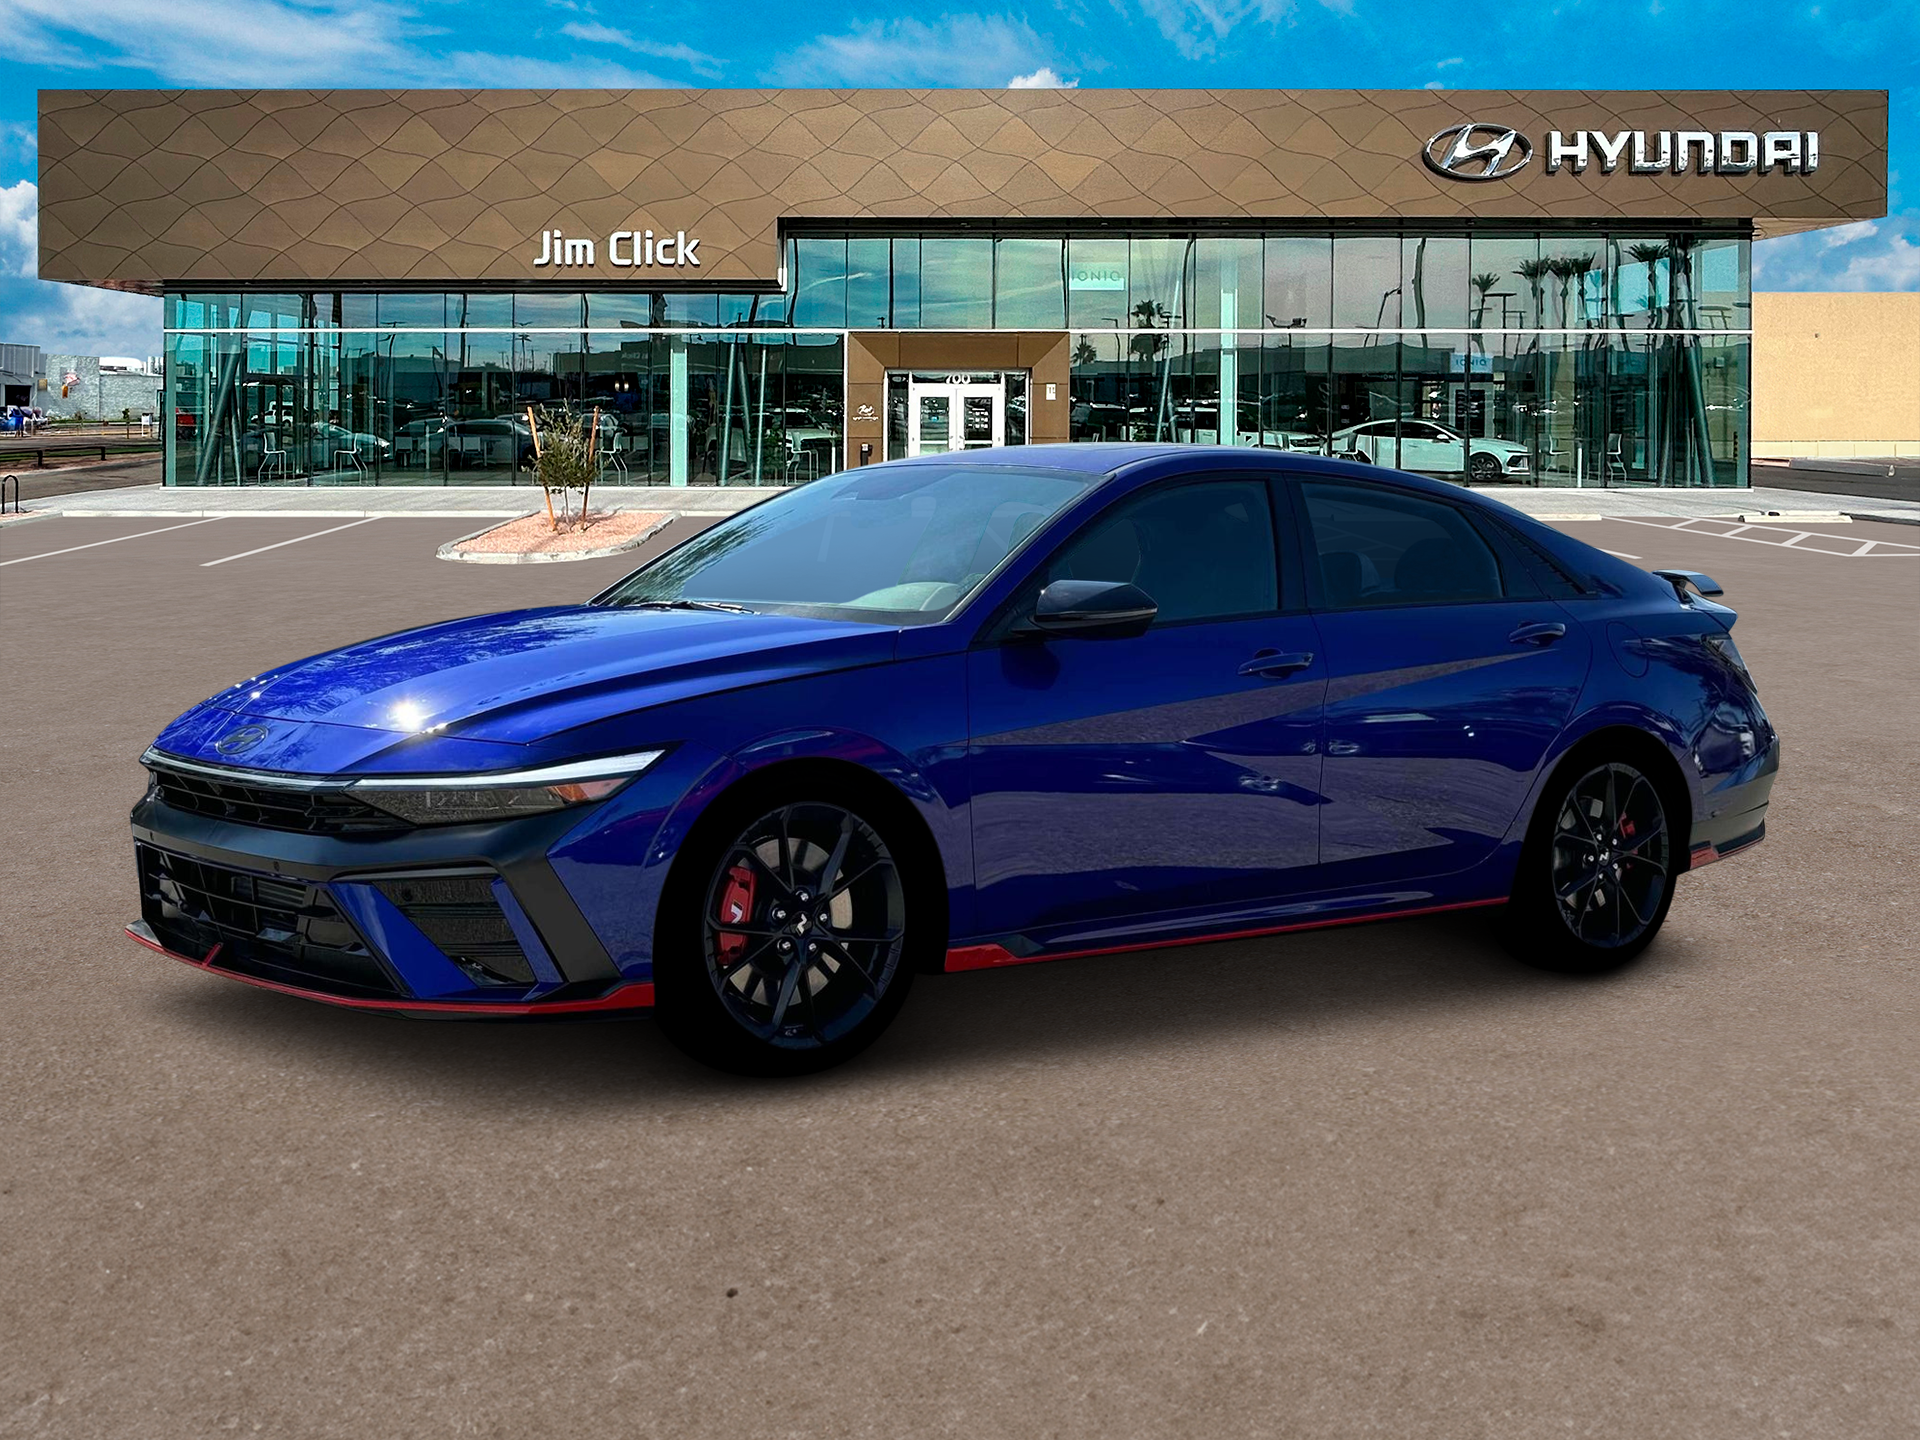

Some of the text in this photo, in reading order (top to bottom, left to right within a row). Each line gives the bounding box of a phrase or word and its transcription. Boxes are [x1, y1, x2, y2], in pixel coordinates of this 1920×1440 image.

[1548, 130, 1820, 174] HYUNDAI
[533, 229, 701, 266] Jim Click
